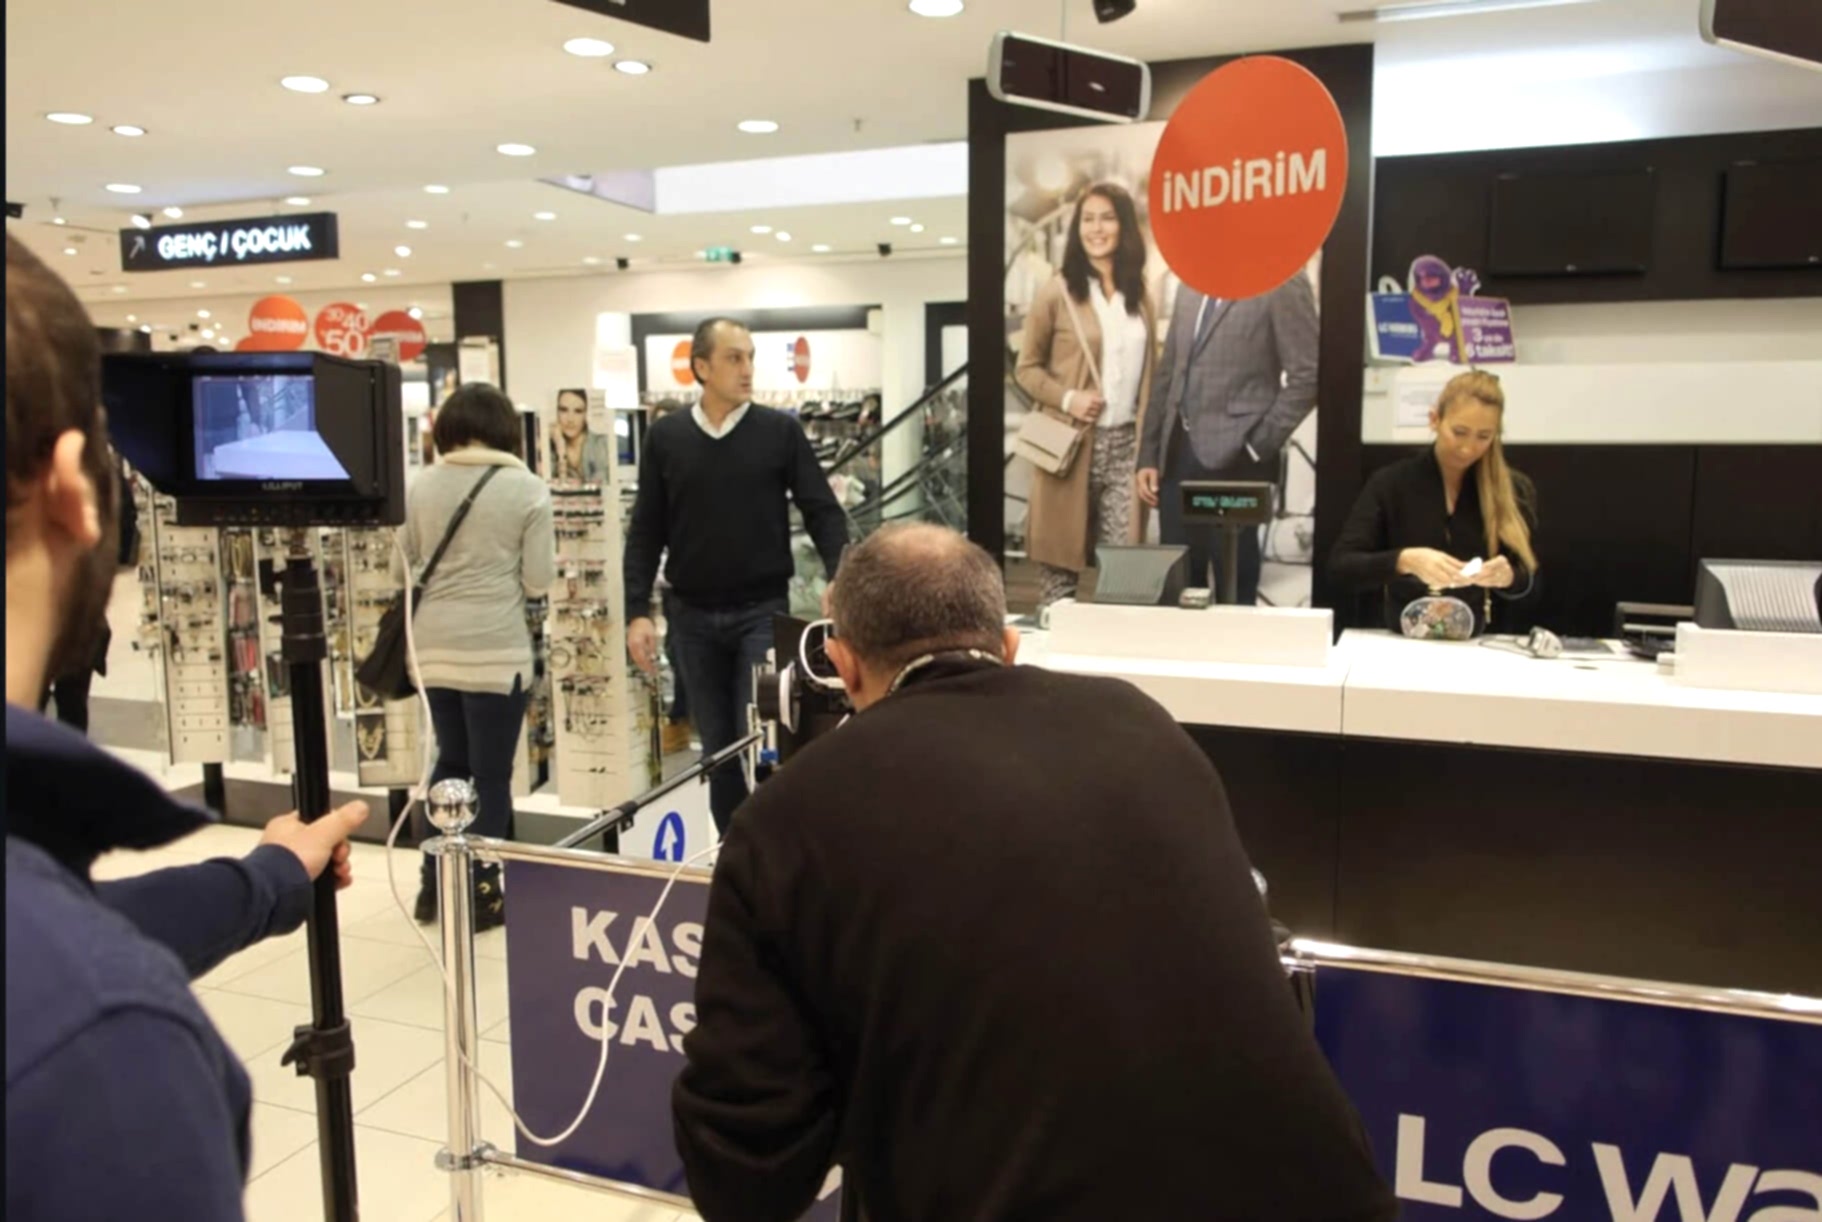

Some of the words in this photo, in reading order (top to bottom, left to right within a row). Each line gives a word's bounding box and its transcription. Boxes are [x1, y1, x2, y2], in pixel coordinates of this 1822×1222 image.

[158, 231, 217, 261] GENÇ
[220, 229, 229, 256] /
[231, 224, 312, 260] ÇOCUK
[1395, 1113, 1567, 1220] LC
